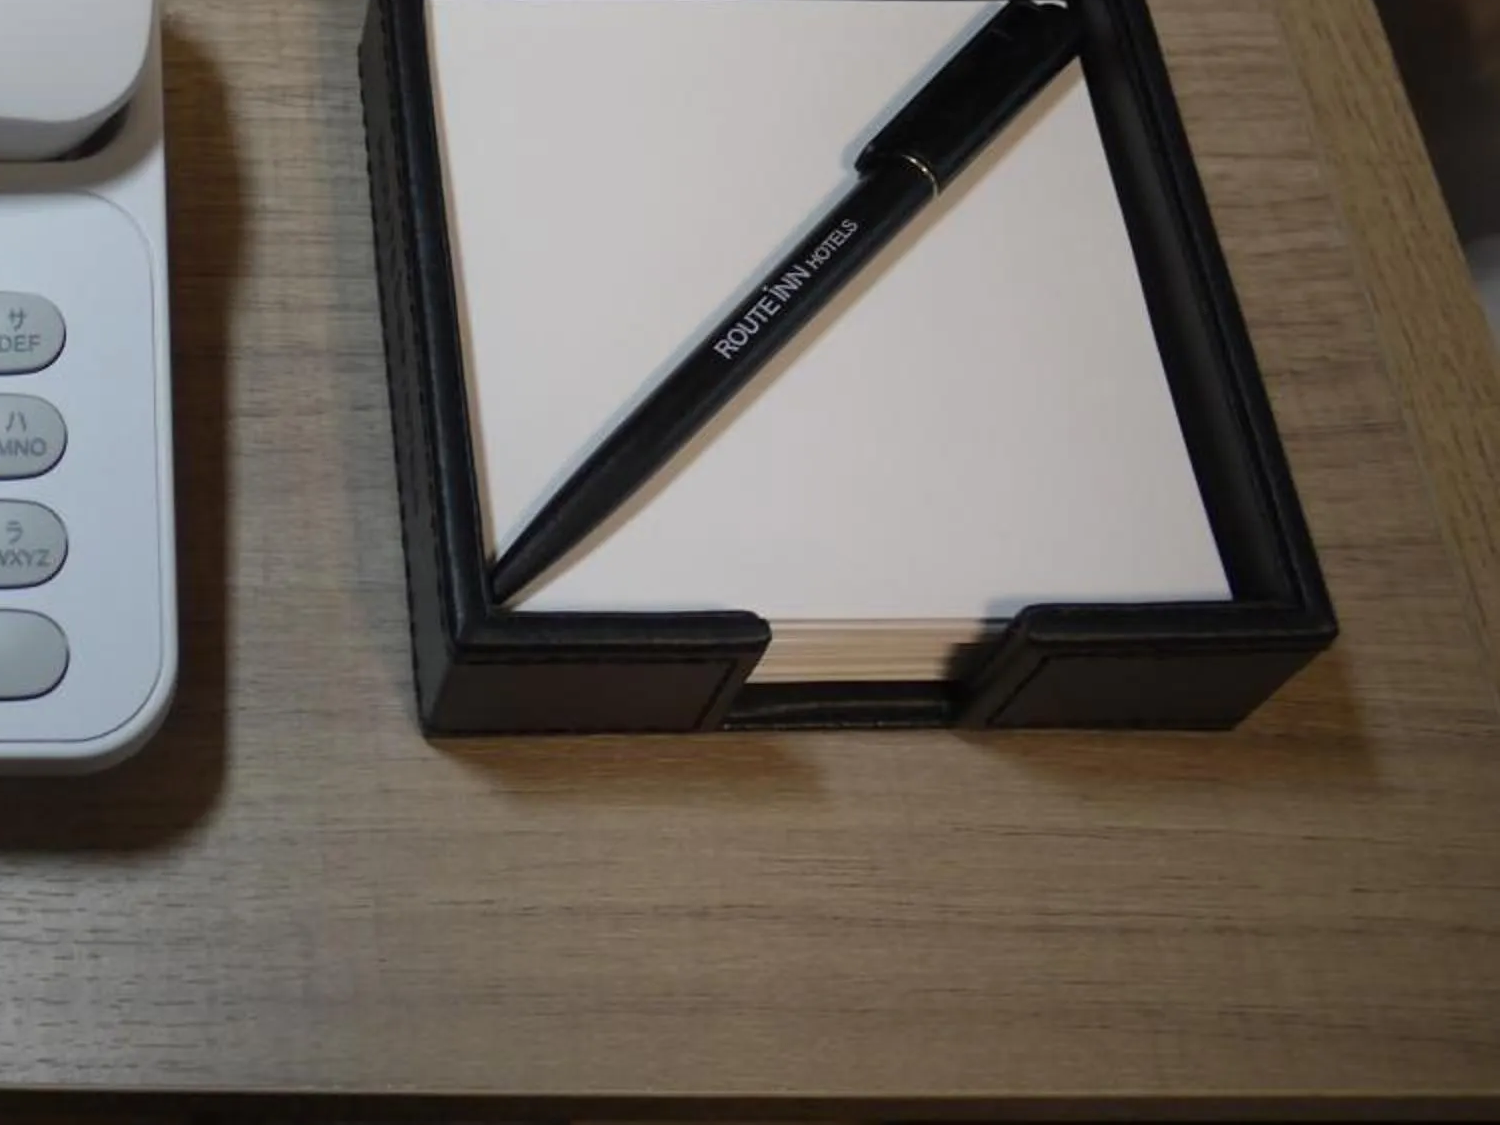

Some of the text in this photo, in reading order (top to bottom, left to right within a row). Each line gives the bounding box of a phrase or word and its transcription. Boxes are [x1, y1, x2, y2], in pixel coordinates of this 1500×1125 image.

[713, 295, 781, 360] ROUTE
[805, 219, 858, 270] HOTELS
[7, 308, 28, 330] サ
[5, 412, 28, 432] ハ
